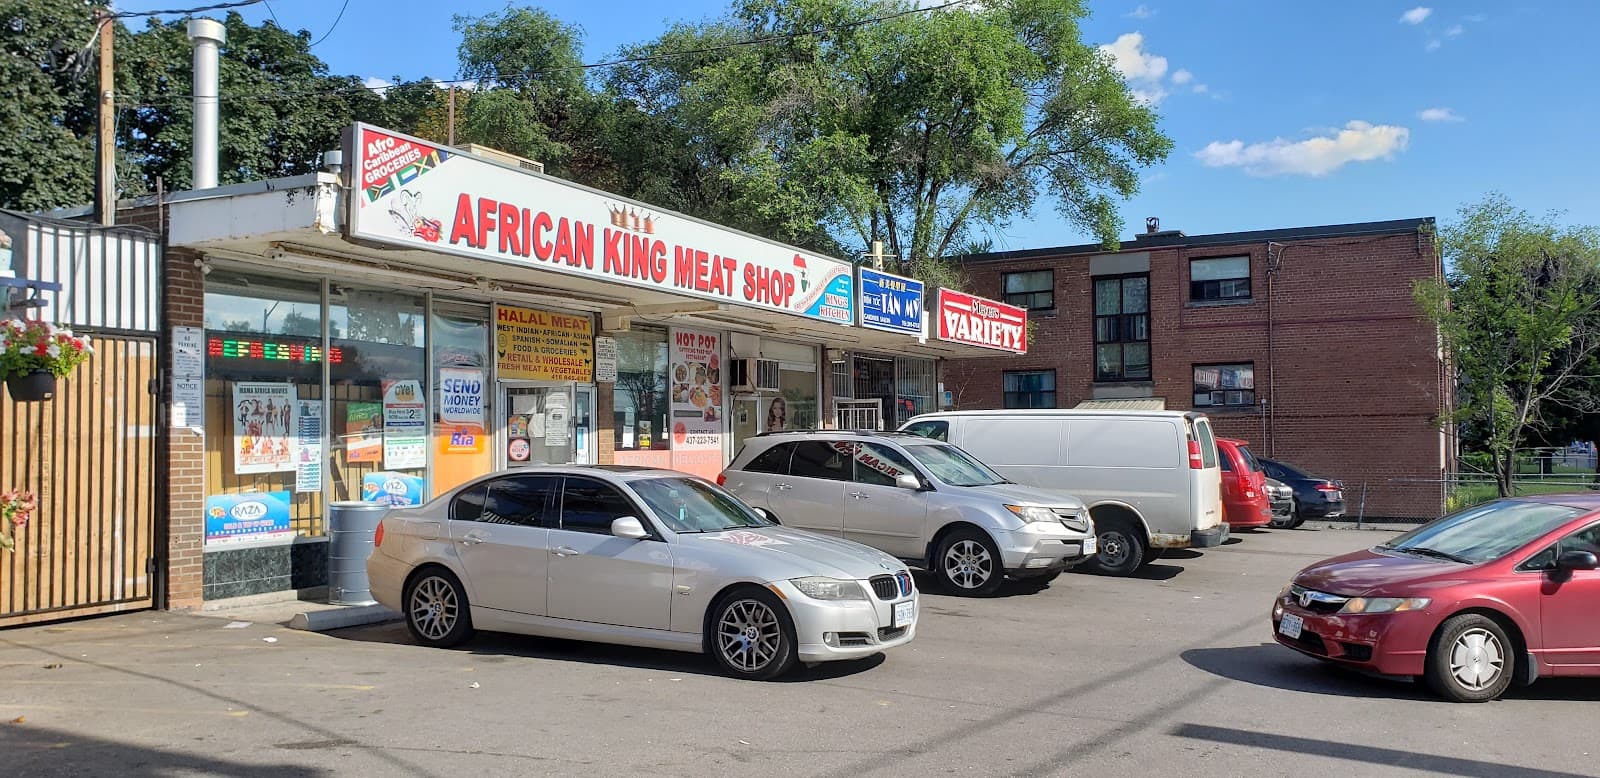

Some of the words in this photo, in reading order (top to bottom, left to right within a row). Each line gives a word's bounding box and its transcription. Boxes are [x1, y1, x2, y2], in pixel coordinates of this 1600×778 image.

[367, 136, 395, 157] Afro
[363, 142, 412, 171] Caribbean
[364, 148, 422, 184] GROCERIES
[449, 193, 595, 270] AFRICAN
[603, 227, 667, 284] KING
[674, 244, 737, 297] MEAT
[742, 262, 796, 308] SHOP
[497, 308, 547, 326] HALAL
[551, 315, 588, 331] MEAT
[820, 306, 848, 320] KITCHEN
[516, 326, 540, 335] INDIAN
[543, 329, 570, 338] AFRICAN
[573, 332, 591, 341] ASIAN
[943, 308, 1023, 350] VARIETY
[512, 335, 541, 344] SPANISH
[546, 338, 578, 347] SOMALIAN
[675, 331, 695, 347] HOT
[698, 336, 717, 351] POT
[208, 338, 342, 363] REFRESHING
[513, 344, 532, 353] FOOD
[541, 347, 578, 356] GROCERIES
[507, 352, 534, 363] RETAIL
[536, 356, 540, 364] &
[542, 356, 583, 367] WHOLESALE
[497, 362, 520, 371] FRESH
[523, 364, 542, 372] MEAT
[550, 366, 591, 376] VEGETABLES
[443, 378, 481, 395] SEND
[443, 395, 481, 406] MONEY
[443, 407, 481, 415] WORLDWIDE
[450, 431, 475, 446] Ria
[234, 505, 261, 517] RAZA
